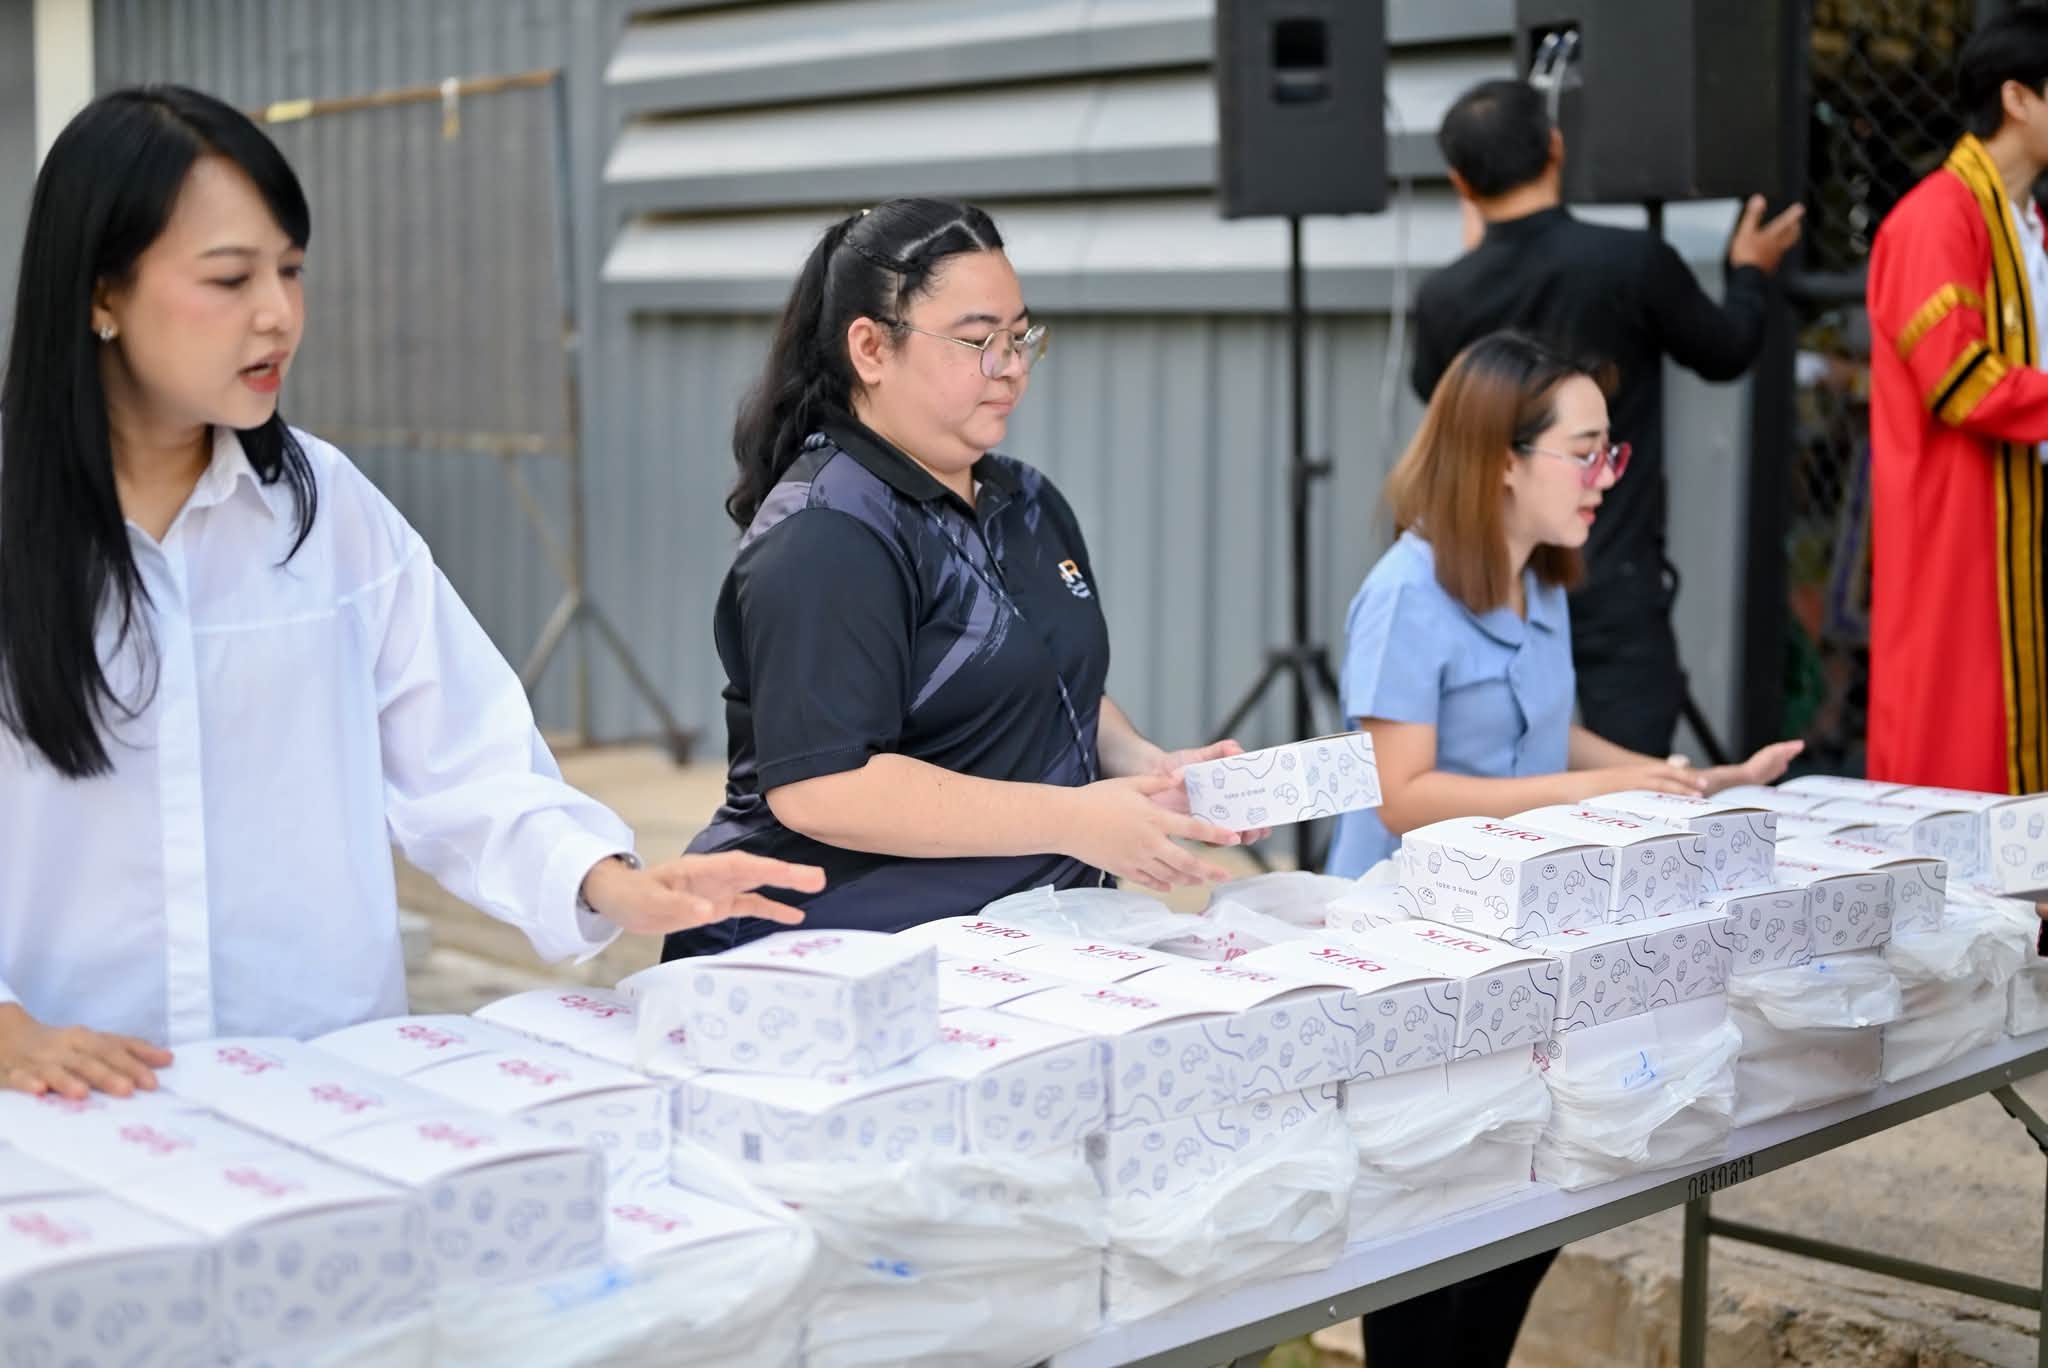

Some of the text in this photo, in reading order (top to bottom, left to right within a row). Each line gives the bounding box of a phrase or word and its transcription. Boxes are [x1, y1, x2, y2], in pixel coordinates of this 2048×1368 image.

[1569, 811, 1641, 829] Srifa
[1472, 823, 1546, 841] Srifa
[1435, 881, 1450, 890] take
[1458, 887, 1478, 896] break
[961, 921, 1031, 939] Srifa
[1415, 929, 1492, 953] Srifa
[1072, 944, 1146, 961] Srifa
[1309, 948, 1388, 973] Srifa
[1687, 1155, 1755, 1201] กองกลาง
